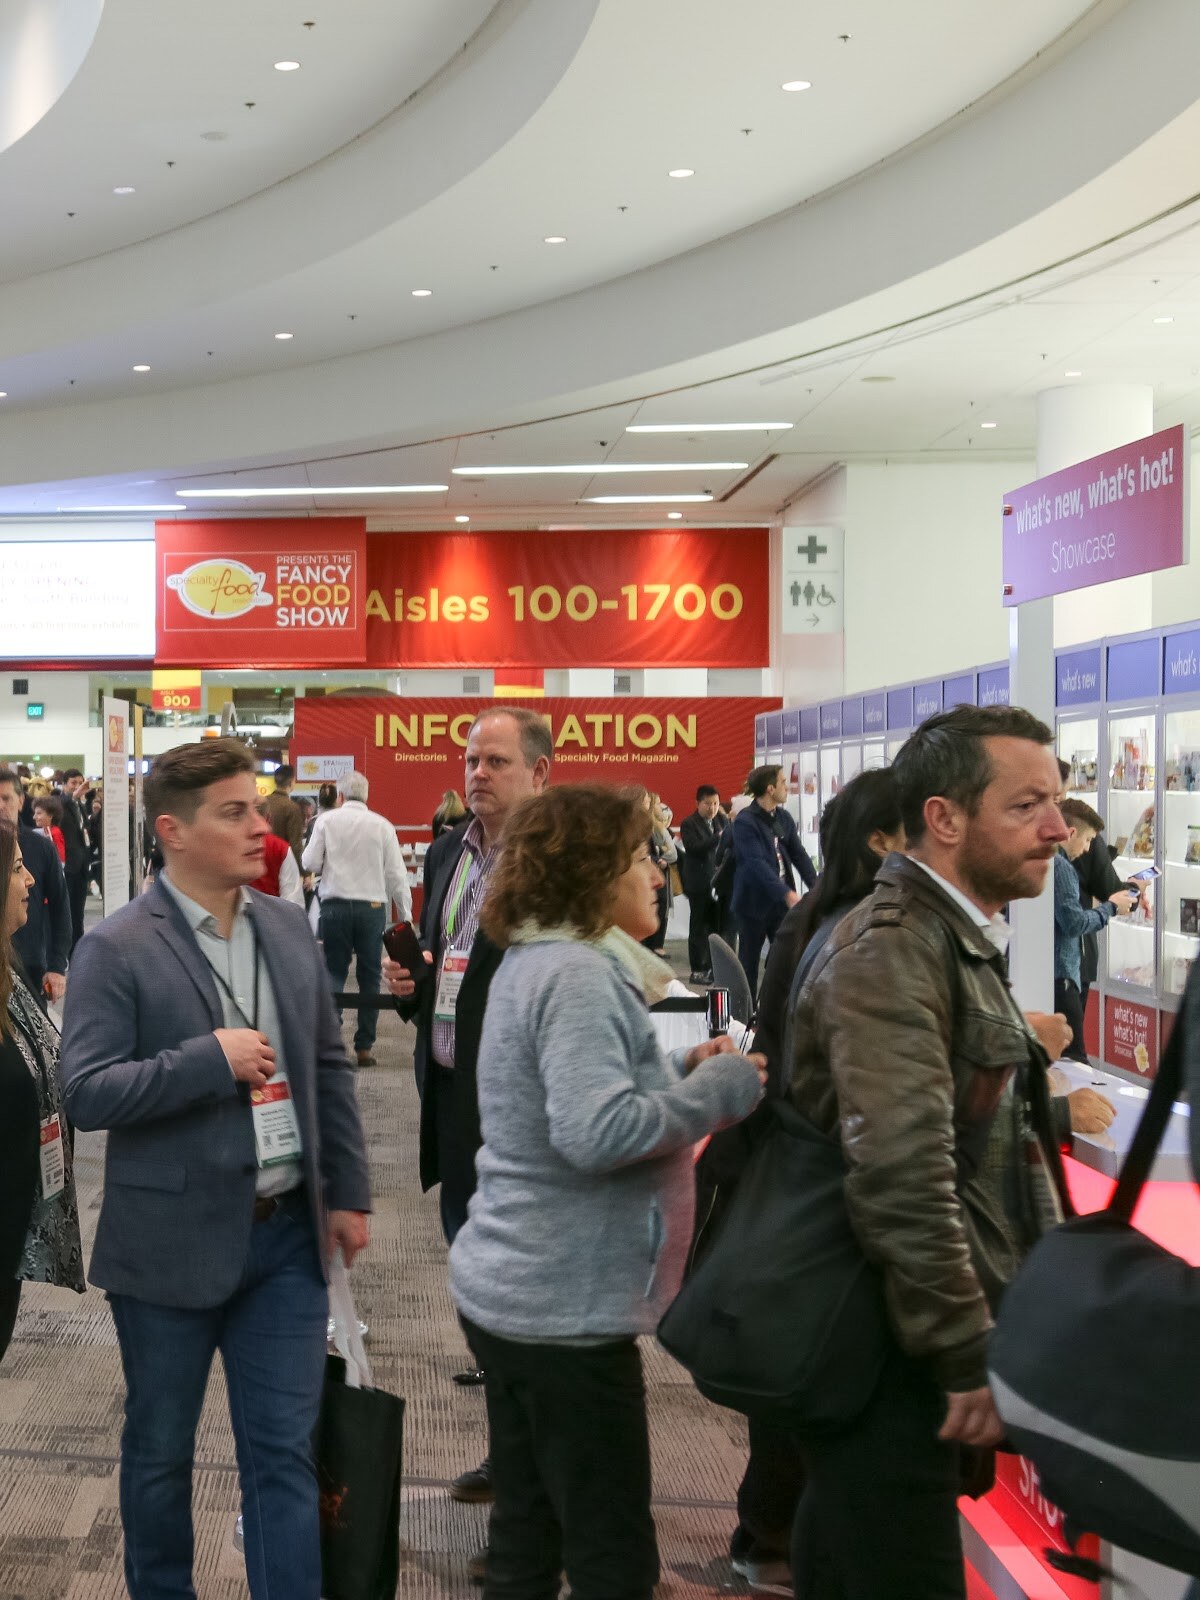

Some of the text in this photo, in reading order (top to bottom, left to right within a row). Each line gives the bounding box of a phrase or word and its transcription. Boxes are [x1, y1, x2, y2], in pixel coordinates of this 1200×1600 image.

[1016, 448, 1174, 534] what's new, what's hot!
[276, 554, 352, 564] PRESENTS THE
[1052, 532, 1116, 573] Showcase
[169, 575, 219, 586] specialty
[276, 565, 352, 584] FANCY
[211, 568, 262, 615] food
[276, 584, 350, 606] FOOD
[365, 583, 744, 623] Aisles 100-1700
[276, 607, 349, 626] SHOW
[1171, 649, 1197, 677] what's
[1062, 668, 1097, 692] what's new
[28, 706, 42, 715] EXIT
[163, 694, 190, 707] 900
[375, 714, 697, 748] INFOATION
[394, 753, 679, 763] Directories Specialty Food Magazine
[1114, 1004, 1149, 1028] what's new
[1113, 1023, 1134, 1043] what's
